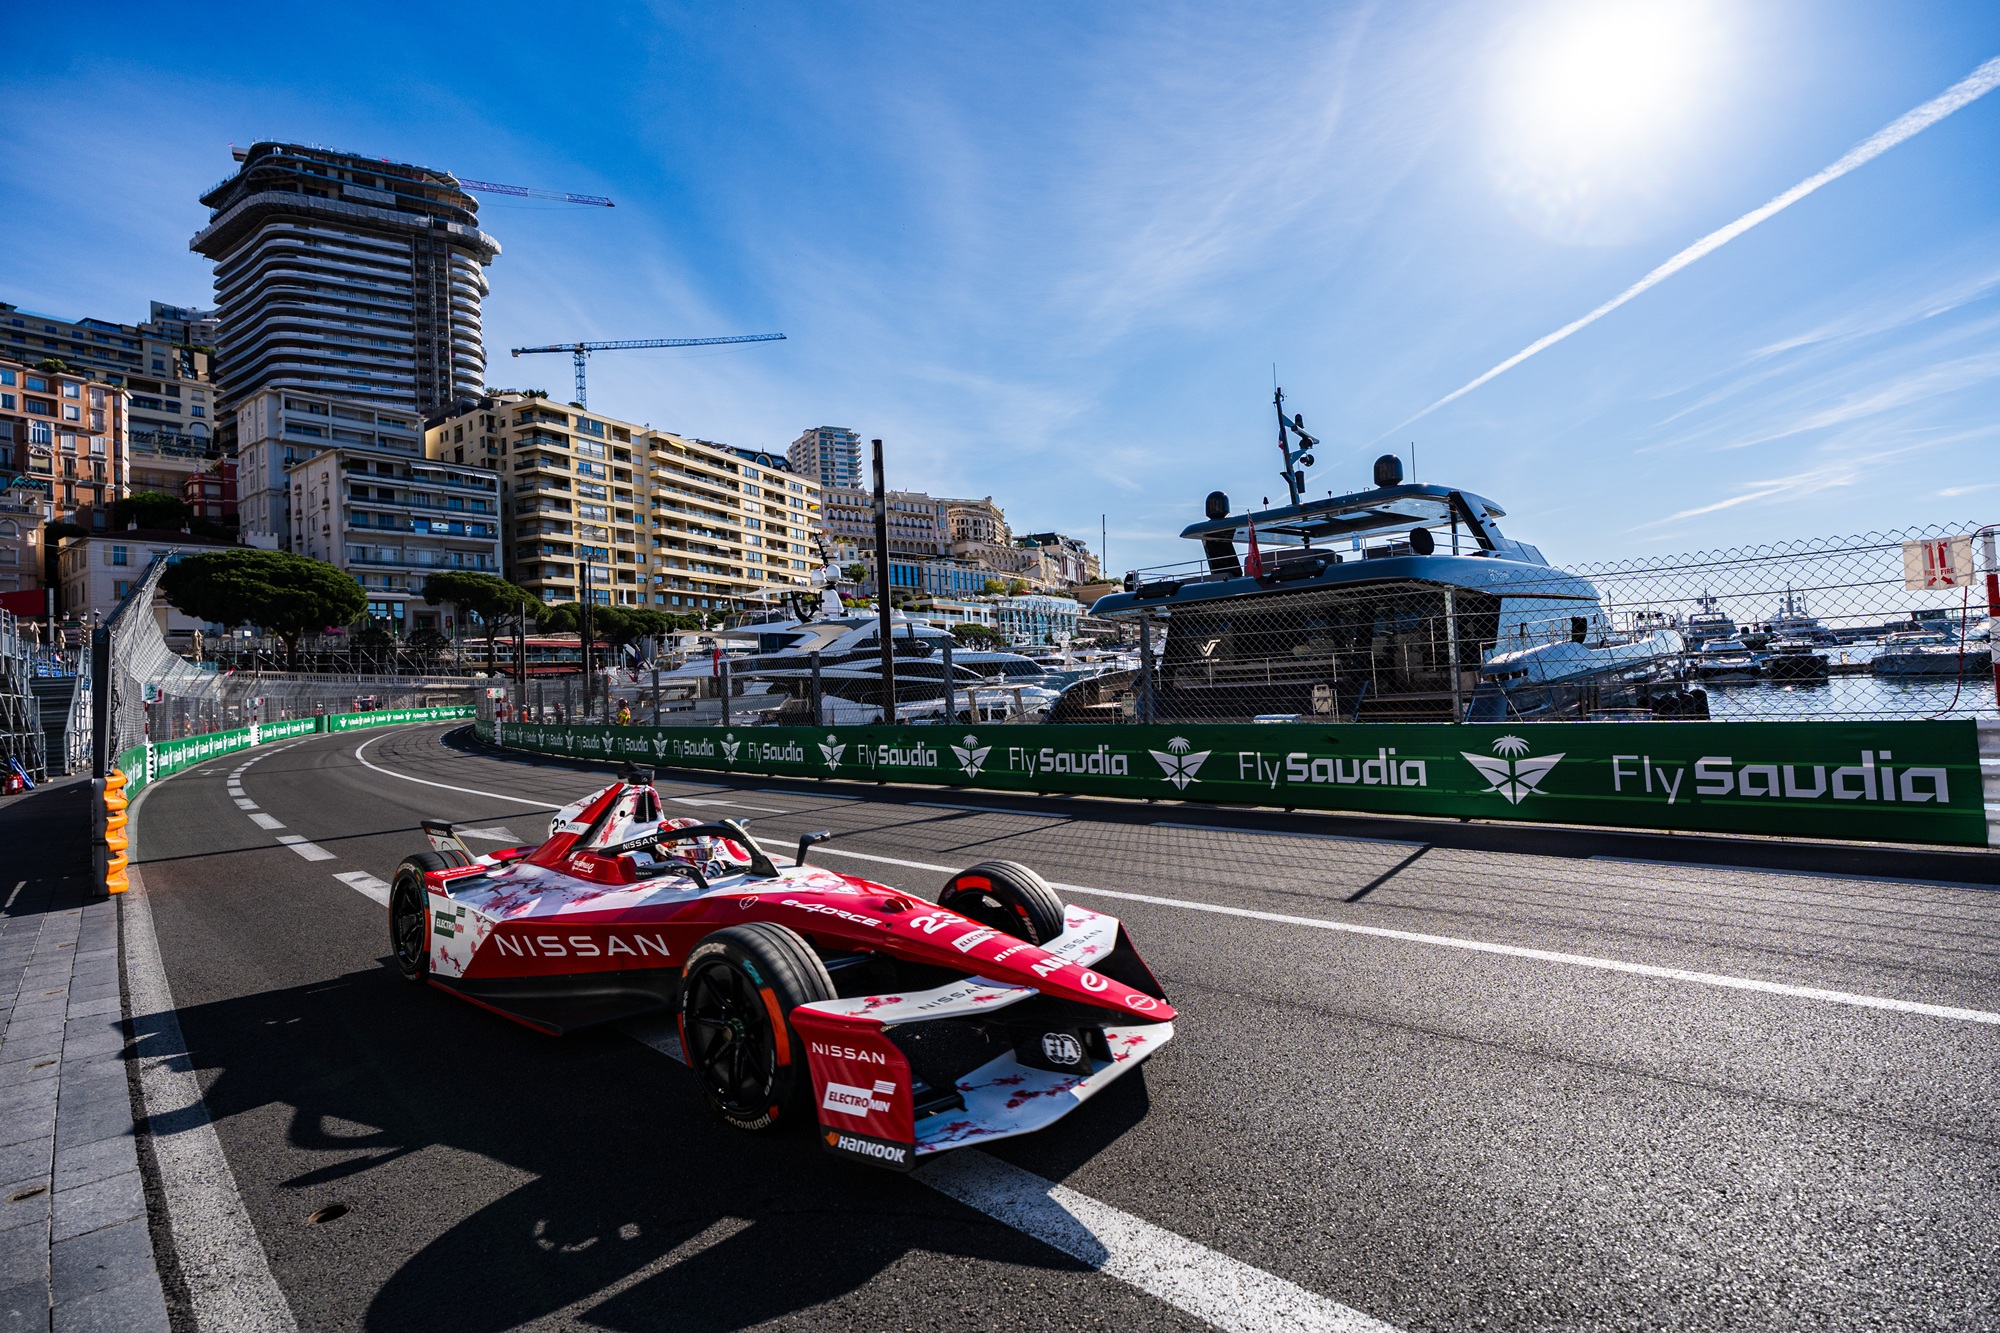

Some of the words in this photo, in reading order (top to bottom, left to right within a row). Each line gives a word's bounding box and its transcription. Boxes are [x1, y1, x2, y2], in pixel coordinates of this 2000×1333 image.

[1940, 567, 1954, 575] FIRE
[763, 740, 804, 762] Saudia
[878, 741, 938, 767] Saudia
[1009, 747, 1036, 778] Fly
[1039, 744, 1128, 776] Saudia
[1238, 751, 1281, 790] Fly
[1286, 747, 1427, 787] Saudia
[1612, 754, 1685, 805] Fly
[1694, 750, 1950, 803] Saudia
[622, 835, 659, 851] NISSAN
[910, 911, 967, 935] 23
[493, 933, 671, 957] NISSAN
[811, 1041, 886, 1066] NISSAN
[828, 1090, 891, 1113] ELECTROMIN
